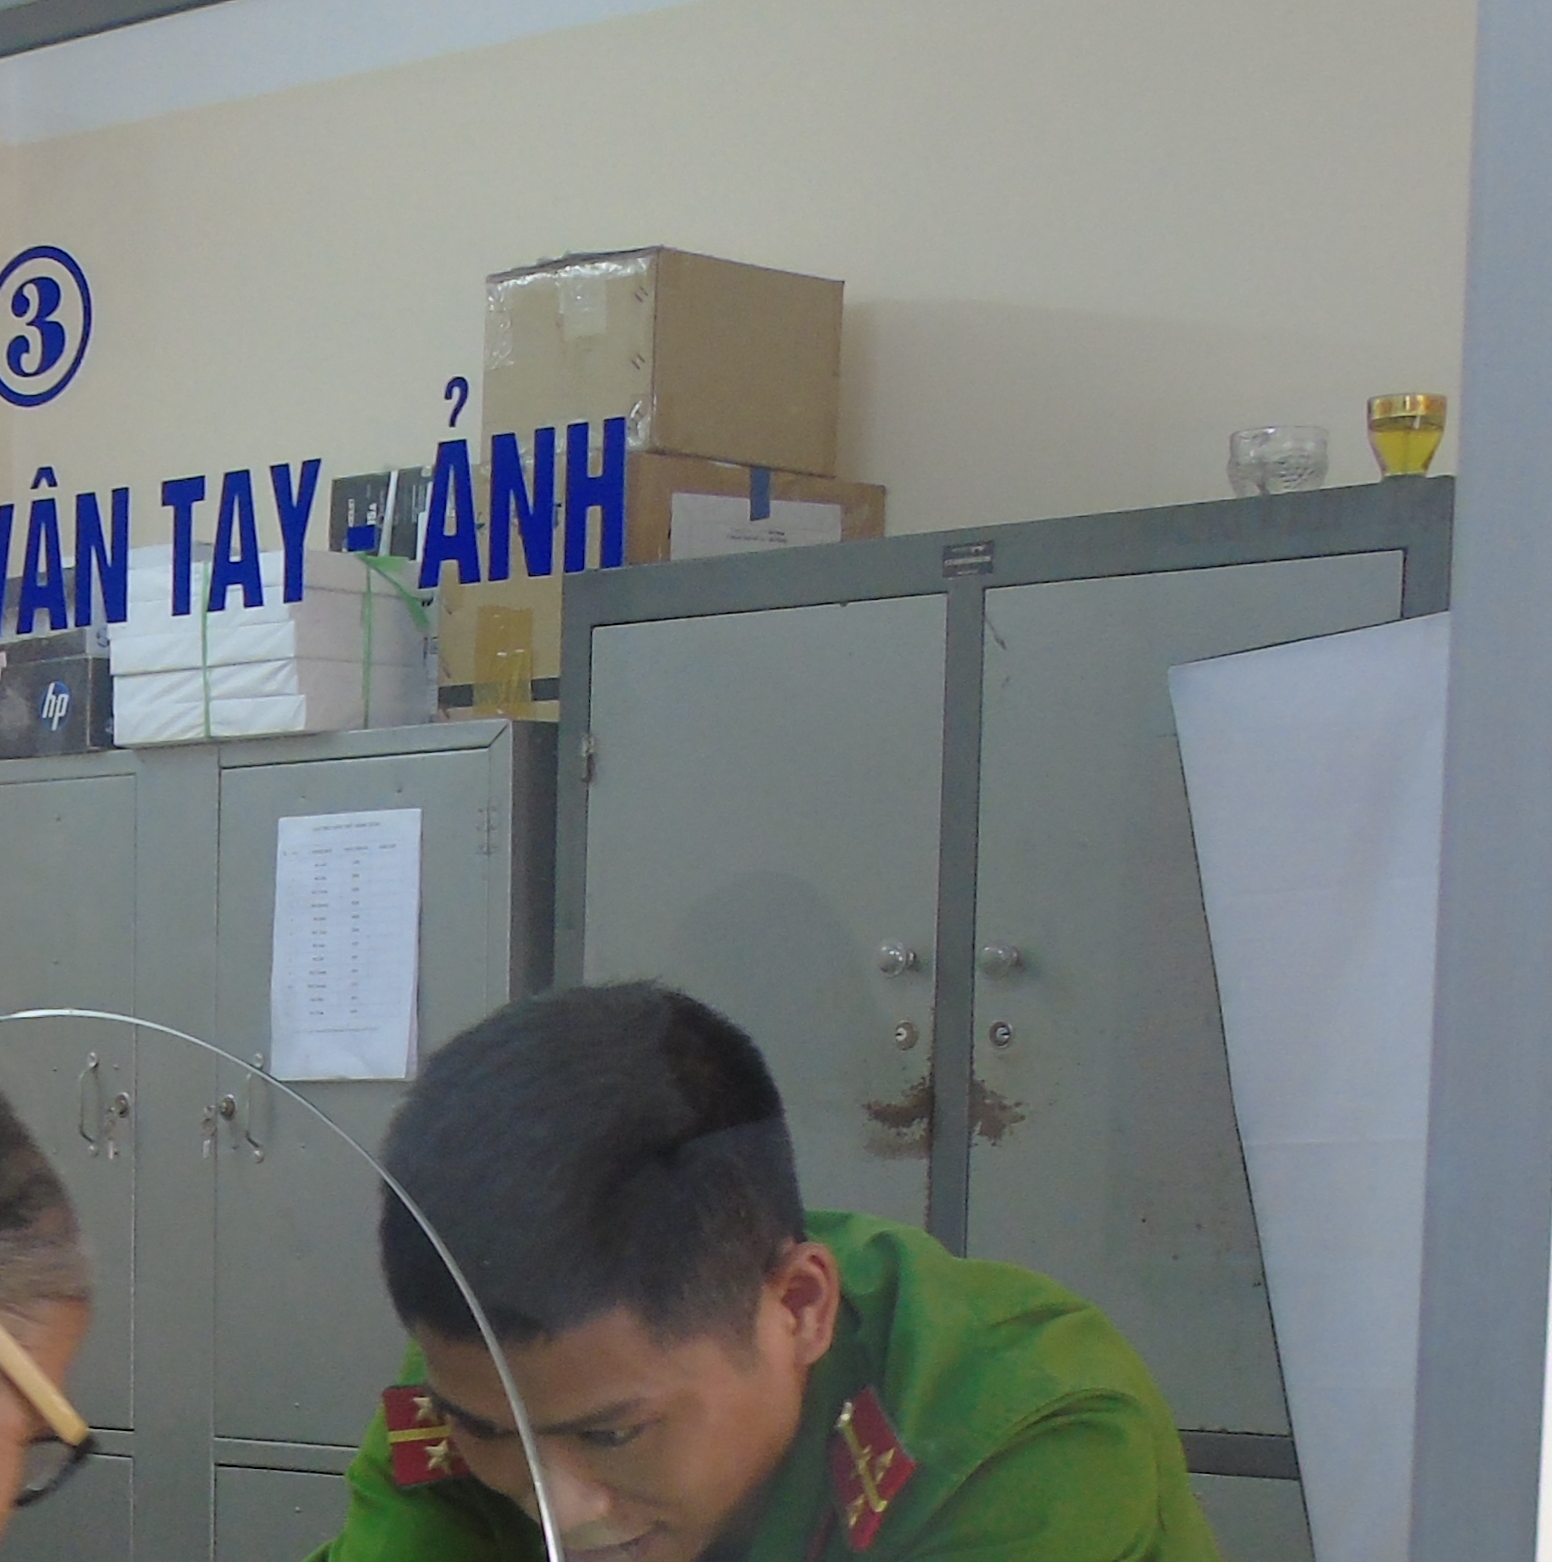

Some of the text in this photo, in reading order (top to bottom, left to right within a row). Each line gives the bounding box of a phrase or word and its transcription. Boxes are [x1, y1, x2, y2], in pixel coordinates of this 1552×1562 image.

[161, 458, 321, 616] TAY
[419, 376, 626, 588] ẢNH
[42, 682, 69, 731] hp
